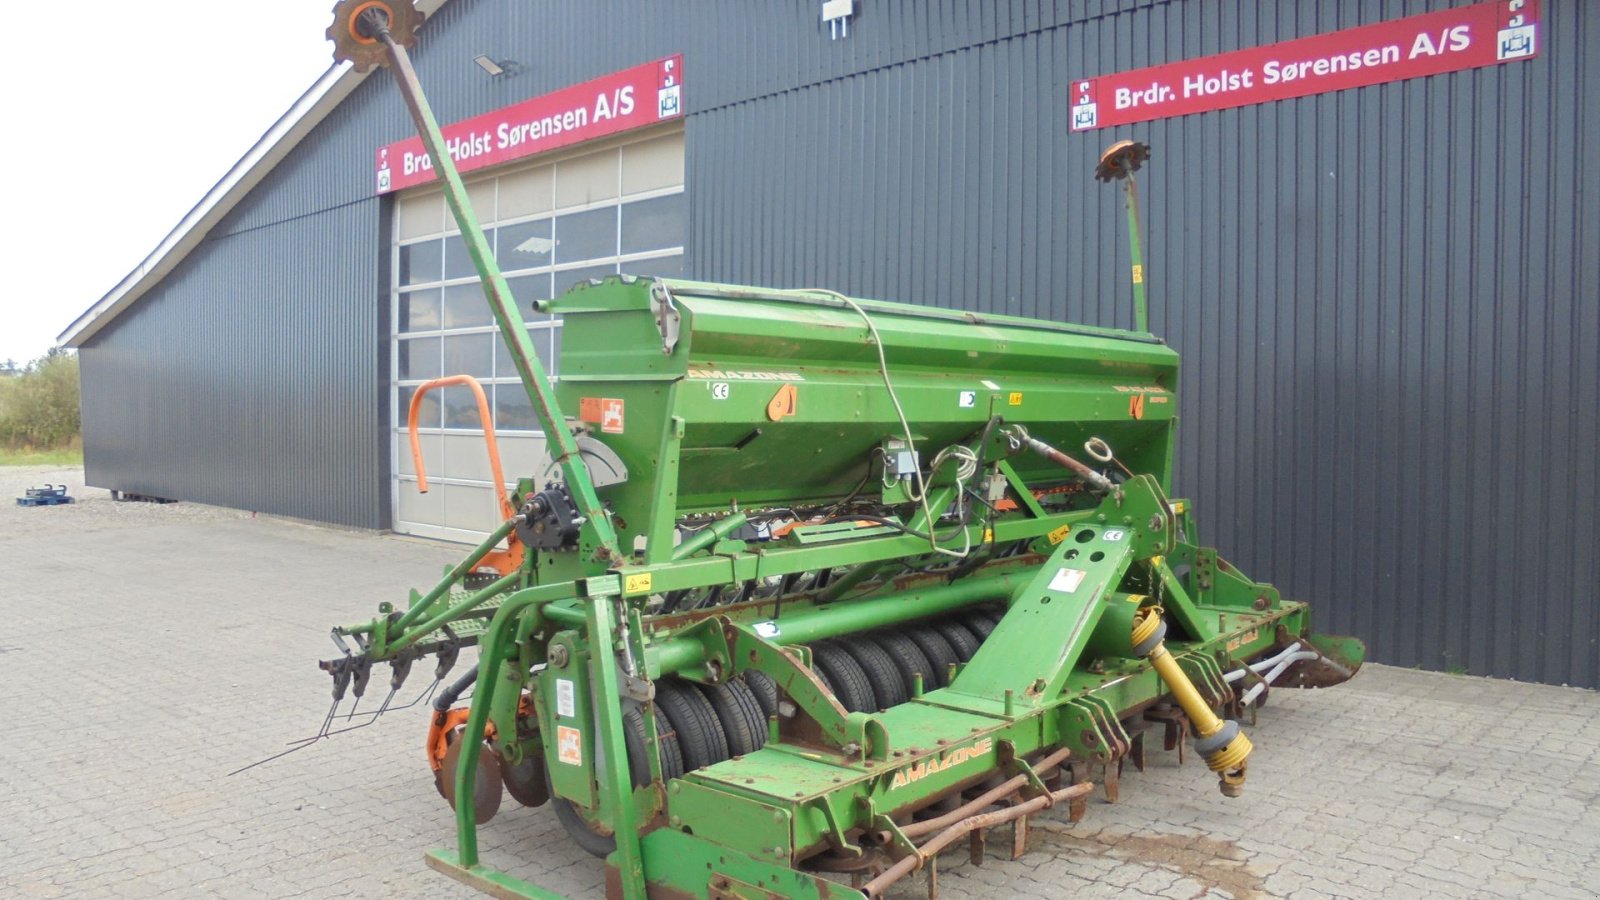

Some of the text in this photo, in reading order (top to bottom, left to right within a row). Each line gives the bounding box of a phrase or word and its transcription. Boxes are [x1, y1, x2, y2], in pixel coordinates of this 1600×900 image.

[1115, 25, 1470, 110] Brdr. Holst Sørensen A/S
[446, 130, 492, 162] Holst
[497, 106, 587, 149] Sørensen
[593, 85, 634, 124] A/S
[687, 369, 806, 381] AMAZONE
[891, 736, 993, 791] AMAZONE
